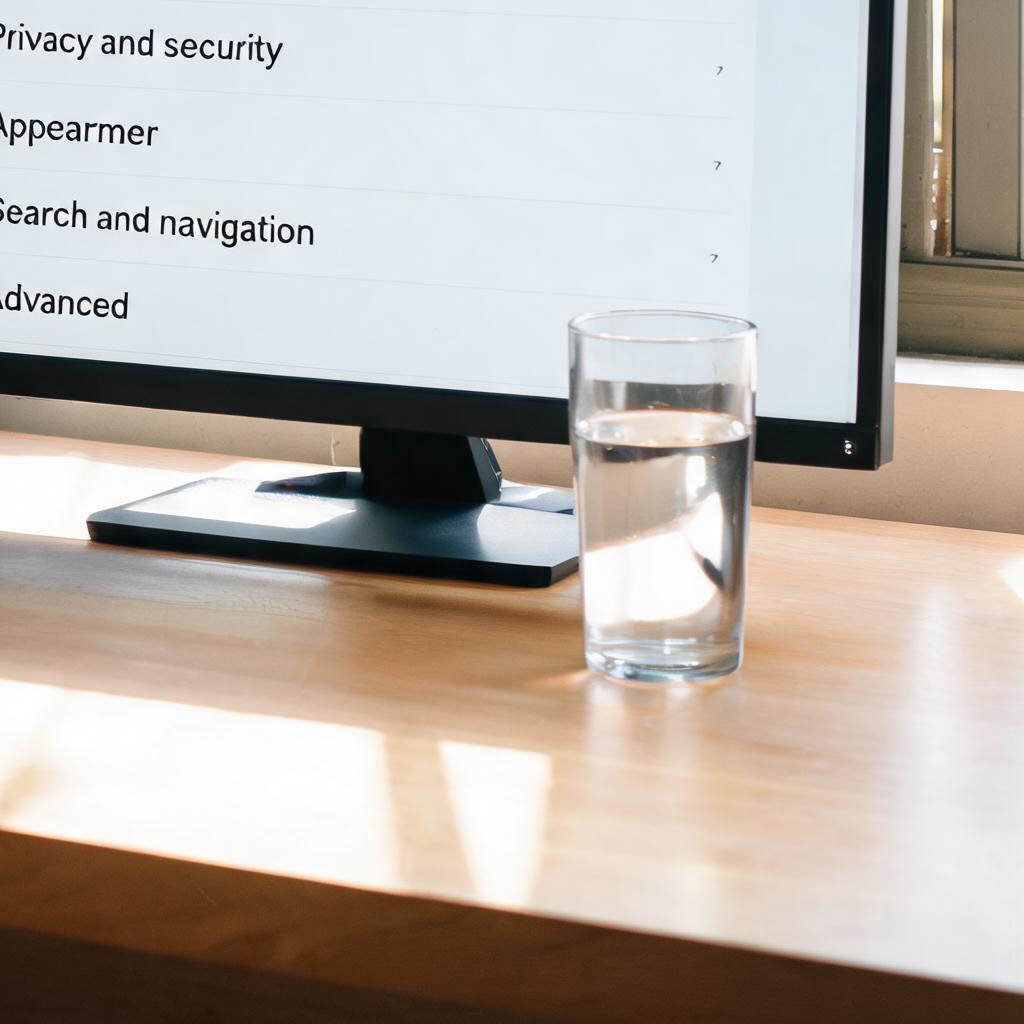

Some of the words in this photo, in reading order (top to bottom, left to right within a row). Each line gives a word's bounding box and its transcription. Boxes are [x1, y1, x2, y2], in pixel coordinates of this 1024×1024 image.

[101, 29, 154, 56] and
[164, 34, 284, 70] security
[97, 206, 150, 233] and
[160, 211, 314, 248] navigation
